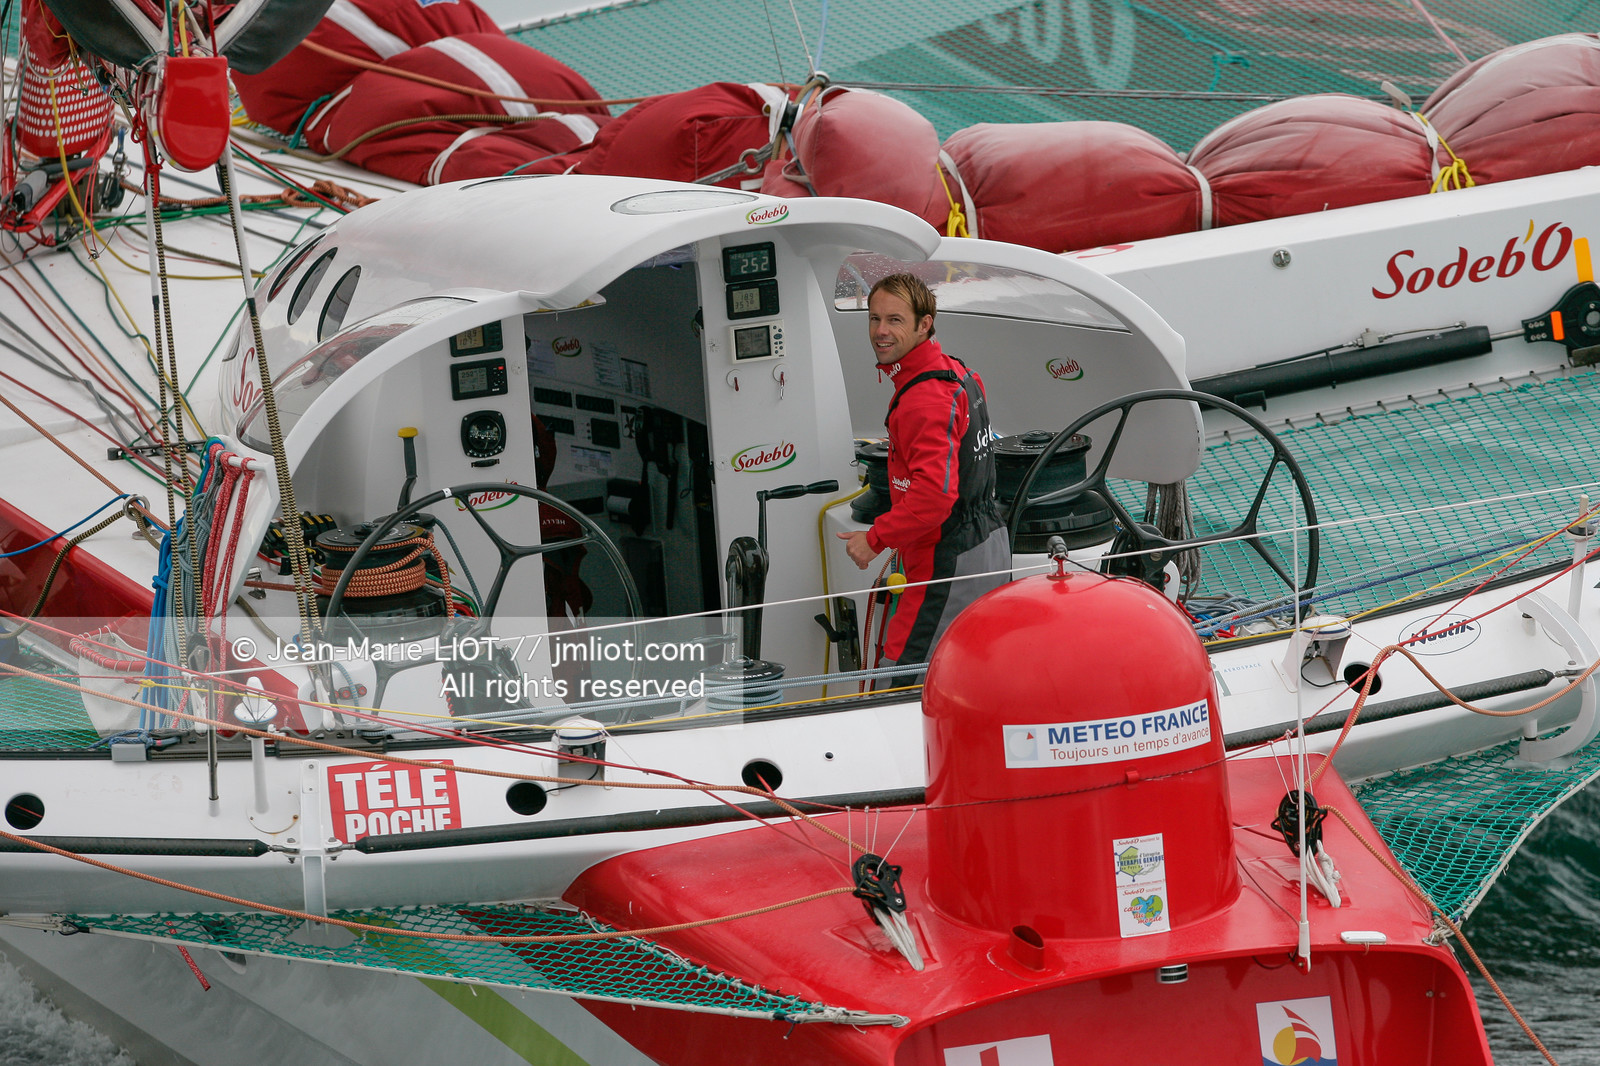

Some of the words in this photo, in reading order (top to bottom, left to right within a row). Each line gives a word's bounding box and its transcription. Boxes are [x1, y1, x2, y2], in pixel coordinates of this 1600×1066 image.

[747, 203, 788, 225] Sodeb'O
[741, 256, 769, 274] 252
[1372, 219, 1573, 299] Sodeb'O
[1050, 357, 1080, 379] Sodeb'O
[734, 440, 794, 472] Sodeb'O
[1048, 719, 1136, 745] METEO
[1141, 703, 1208, 735] FRANCE
[1051, 745, 1109, 762] Toujours
[1113, 744, 1130, 755] un
[1134, 736, 1170, 752] temps
[1172, 727, 1210, 745] d'avance
